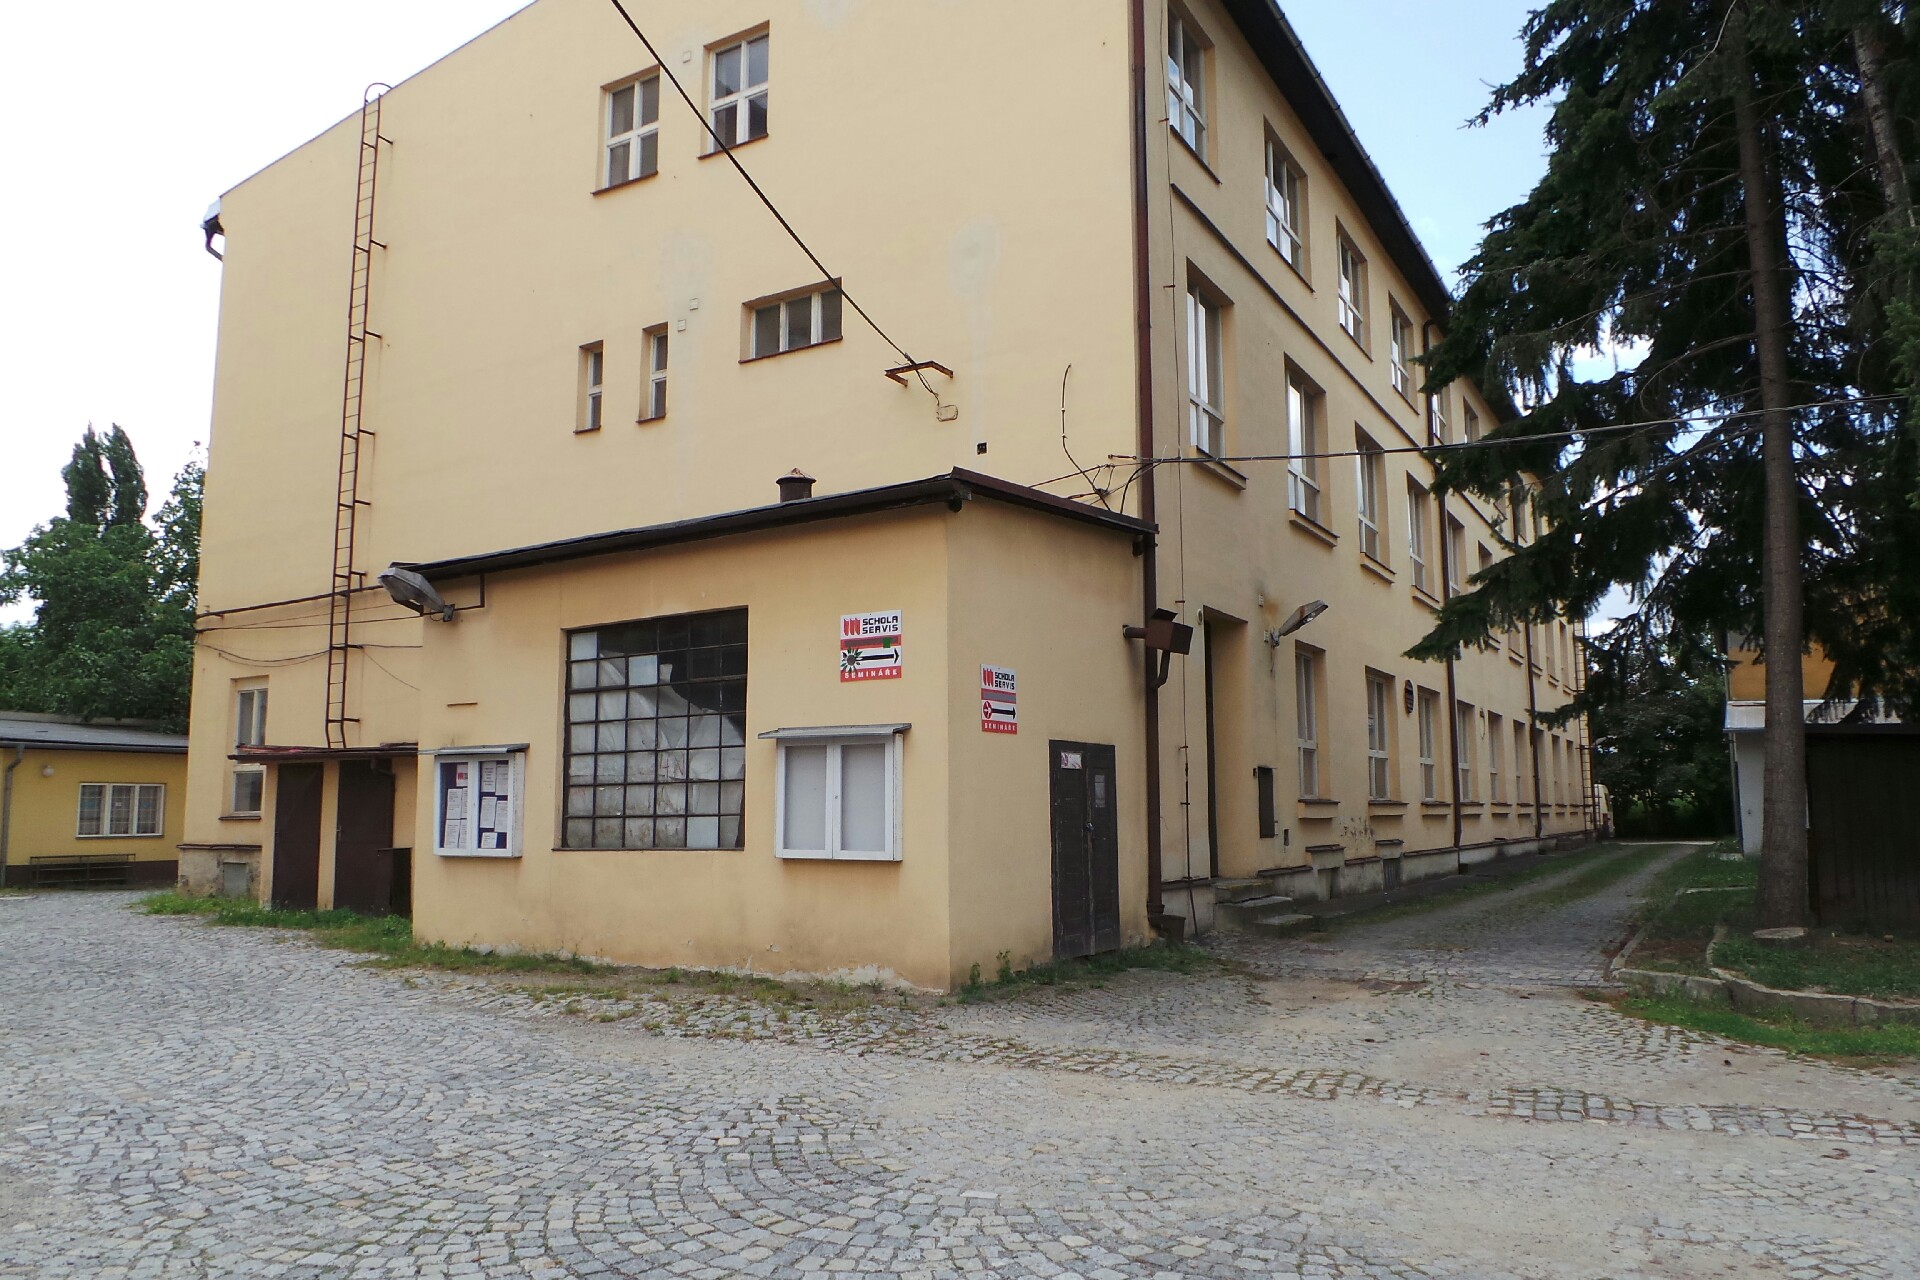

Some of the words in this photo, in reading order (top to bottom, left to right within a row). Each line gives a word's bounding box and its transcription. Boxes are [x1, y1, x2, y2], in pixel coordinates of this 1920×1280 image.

[862, 615, 899, 626] SCHOLA
[862, 624, 899, 635] SERVIS
[994, 671, 1015, 682] SCHOLA
[994, 680, 1015, 690] SERVIS
